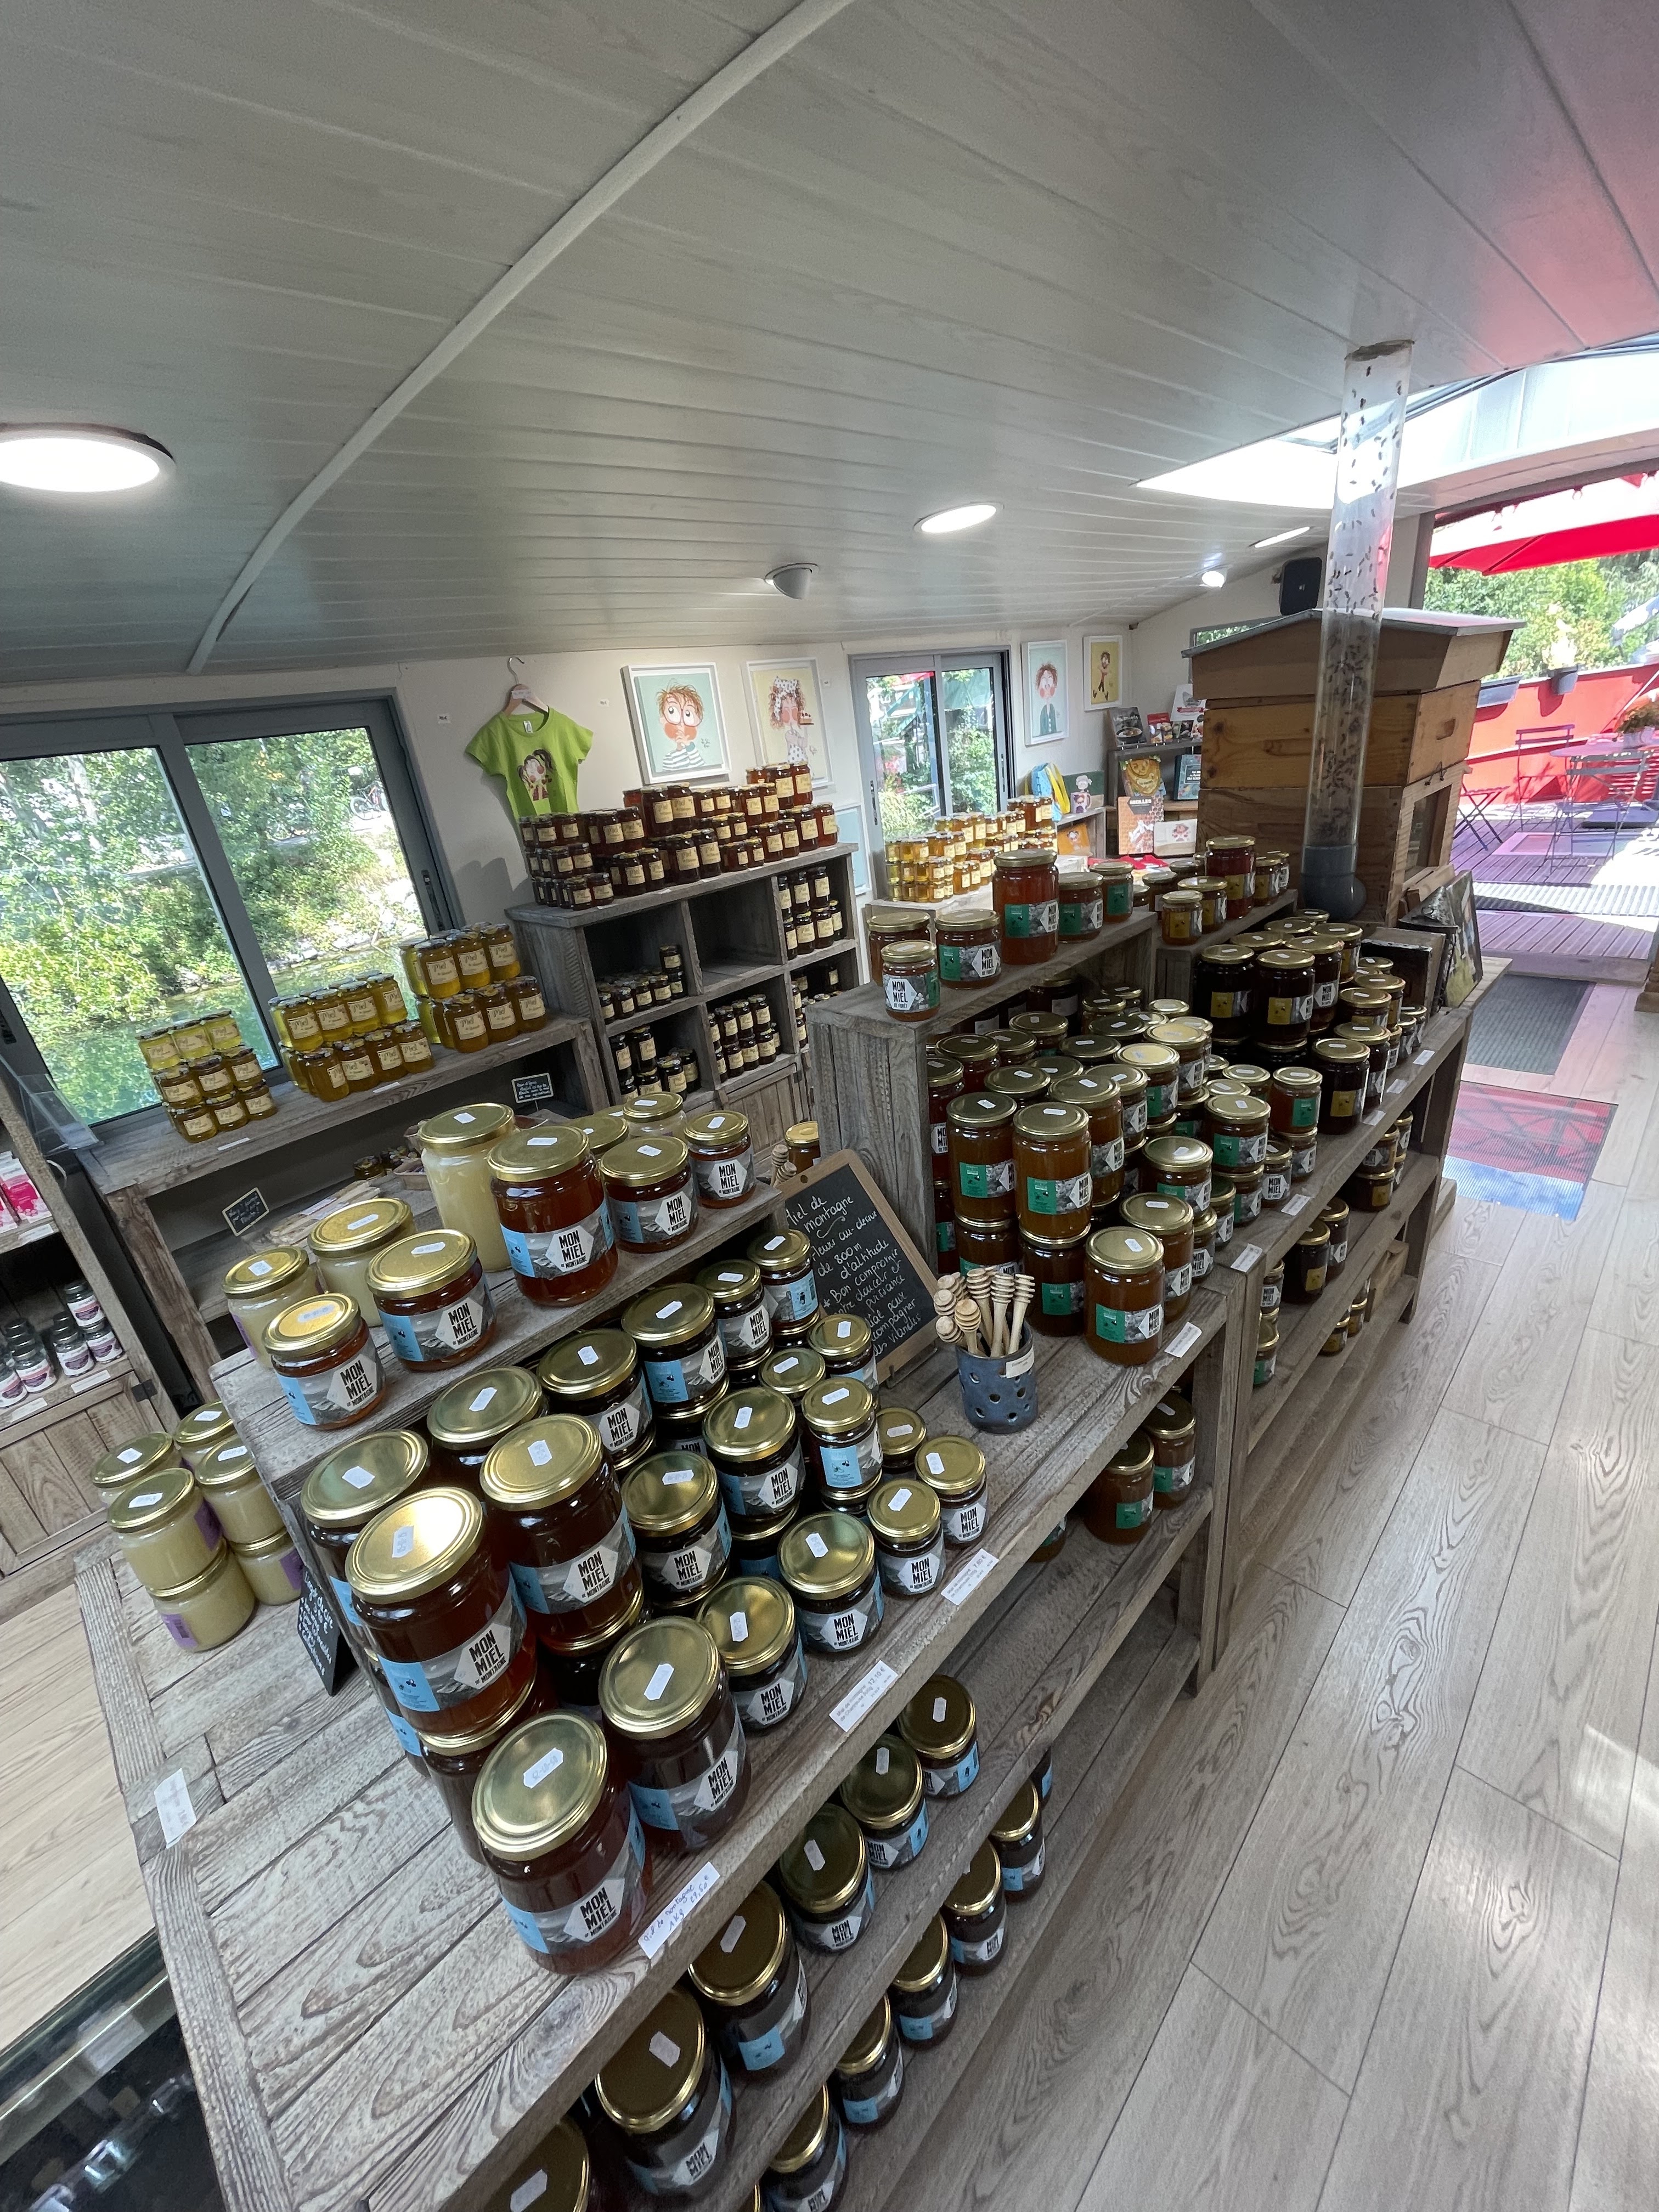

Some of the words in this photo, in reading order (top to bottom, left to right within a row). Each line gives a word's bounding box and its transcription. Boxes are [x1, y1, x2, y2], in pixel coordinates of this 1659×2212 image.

[464, 953, 477, 963] Miel
[496, 946, 508, 956] Miel
[981, 947, 992, 959] MON
[432, 962, 447, 972] Miel
[981, 959, 994, 970] MIEL
[893, 981, 905, 992] MON
[893, 992, 908, 1003] MIEL
[321, 1009, 336, 1023] Miel
[353, 1002, 368, 1014] Miel
[294, 1018, 309, 1030] Miel
[460, 1018, 475, 1029] Miel
[937, 1128, 946, 1137] MO
[719, 1163, 736, 1178] MON
[720, 1175, 740, 1189] MIEL
[1268, 1185, 1282, 1194] MIEL
[667, 1195, 683, 1214] MON
[811, 1195, 827, 1211] de
[669, 1209, 687, 1226] MIEL
[804, 1194, 854, 1234] montagne
[558, 1230, 580, 1249] MON
[562, 1244, 586, 1262] MIEL
[840, 1241, 890, 1280] d'altitude
[566, 1256, 587, 1269] MONTAGNE
[817, 1264, 833, 1278] de
[1193, 1261, 1205, 1272] MIEL
[830, 1285, 851, 1304] Bon
[854, 1248, 899, 1288] compromis
[856, 1272, 889, 1302] douceur
[448, 1302, 471, 1325] MON
[749, 1309, 764, 1328] MON
[452, 1316, 477, 1339] MIEL
[751, 1323, 767, 1340] MIEL
[889, 1314, 923, 1344] viandes
[458, 1329, 479, 1346] MONTAGNE
[707, 1340, 720, 1362] MON
[340, 1359, 365, 1386] MON
[710, 1355, 724, 1373] MIEL
[346, 1373, 373, 1400] MIEL
[607, 1407, 628, 1429] MON
[610, 1421, 633, 1442] MIEL
[771, 1468, 789, 1488] MON
[772, 1481, 792, 1499] MIEL
[960, 1506, 978, 1523] MON
[961, 1520, 980, 1534] MIEL
[578, 1551, 602, 1577] MON
[674, 1550, 697, 1569] MON
[911, 1557, 930, 1573] MON
[582, 1566, 610, 1592] MIEL
[677, 1564, 702, 1581] MIEL
[912, 1570, 933, 1584] MIEL
[586, 1578, 612, 1599] MONTAGNE
[833, 1612, 855, 1628] MON
[835, 1626, 859, 1643] MIEL
[469, 1629, 496, 1662] MON
[474, 1644, 505, 1677] MIEL
[481, 1657, 507, 1684] MONTAGNE
[760, 1683, 781, 1705] MON
[763, 1697, 787, 1719] MIEL
[708, 1757, 728, 1784] MON
[711, 1772, 733, 1799] MIEL
[580, 1887, 607, 1917] MON
[585, 1900, 616, 1931] MIEL
[832, 1919, 850, 1938] MON
[833, 1930, 853, 1945] MIEL
